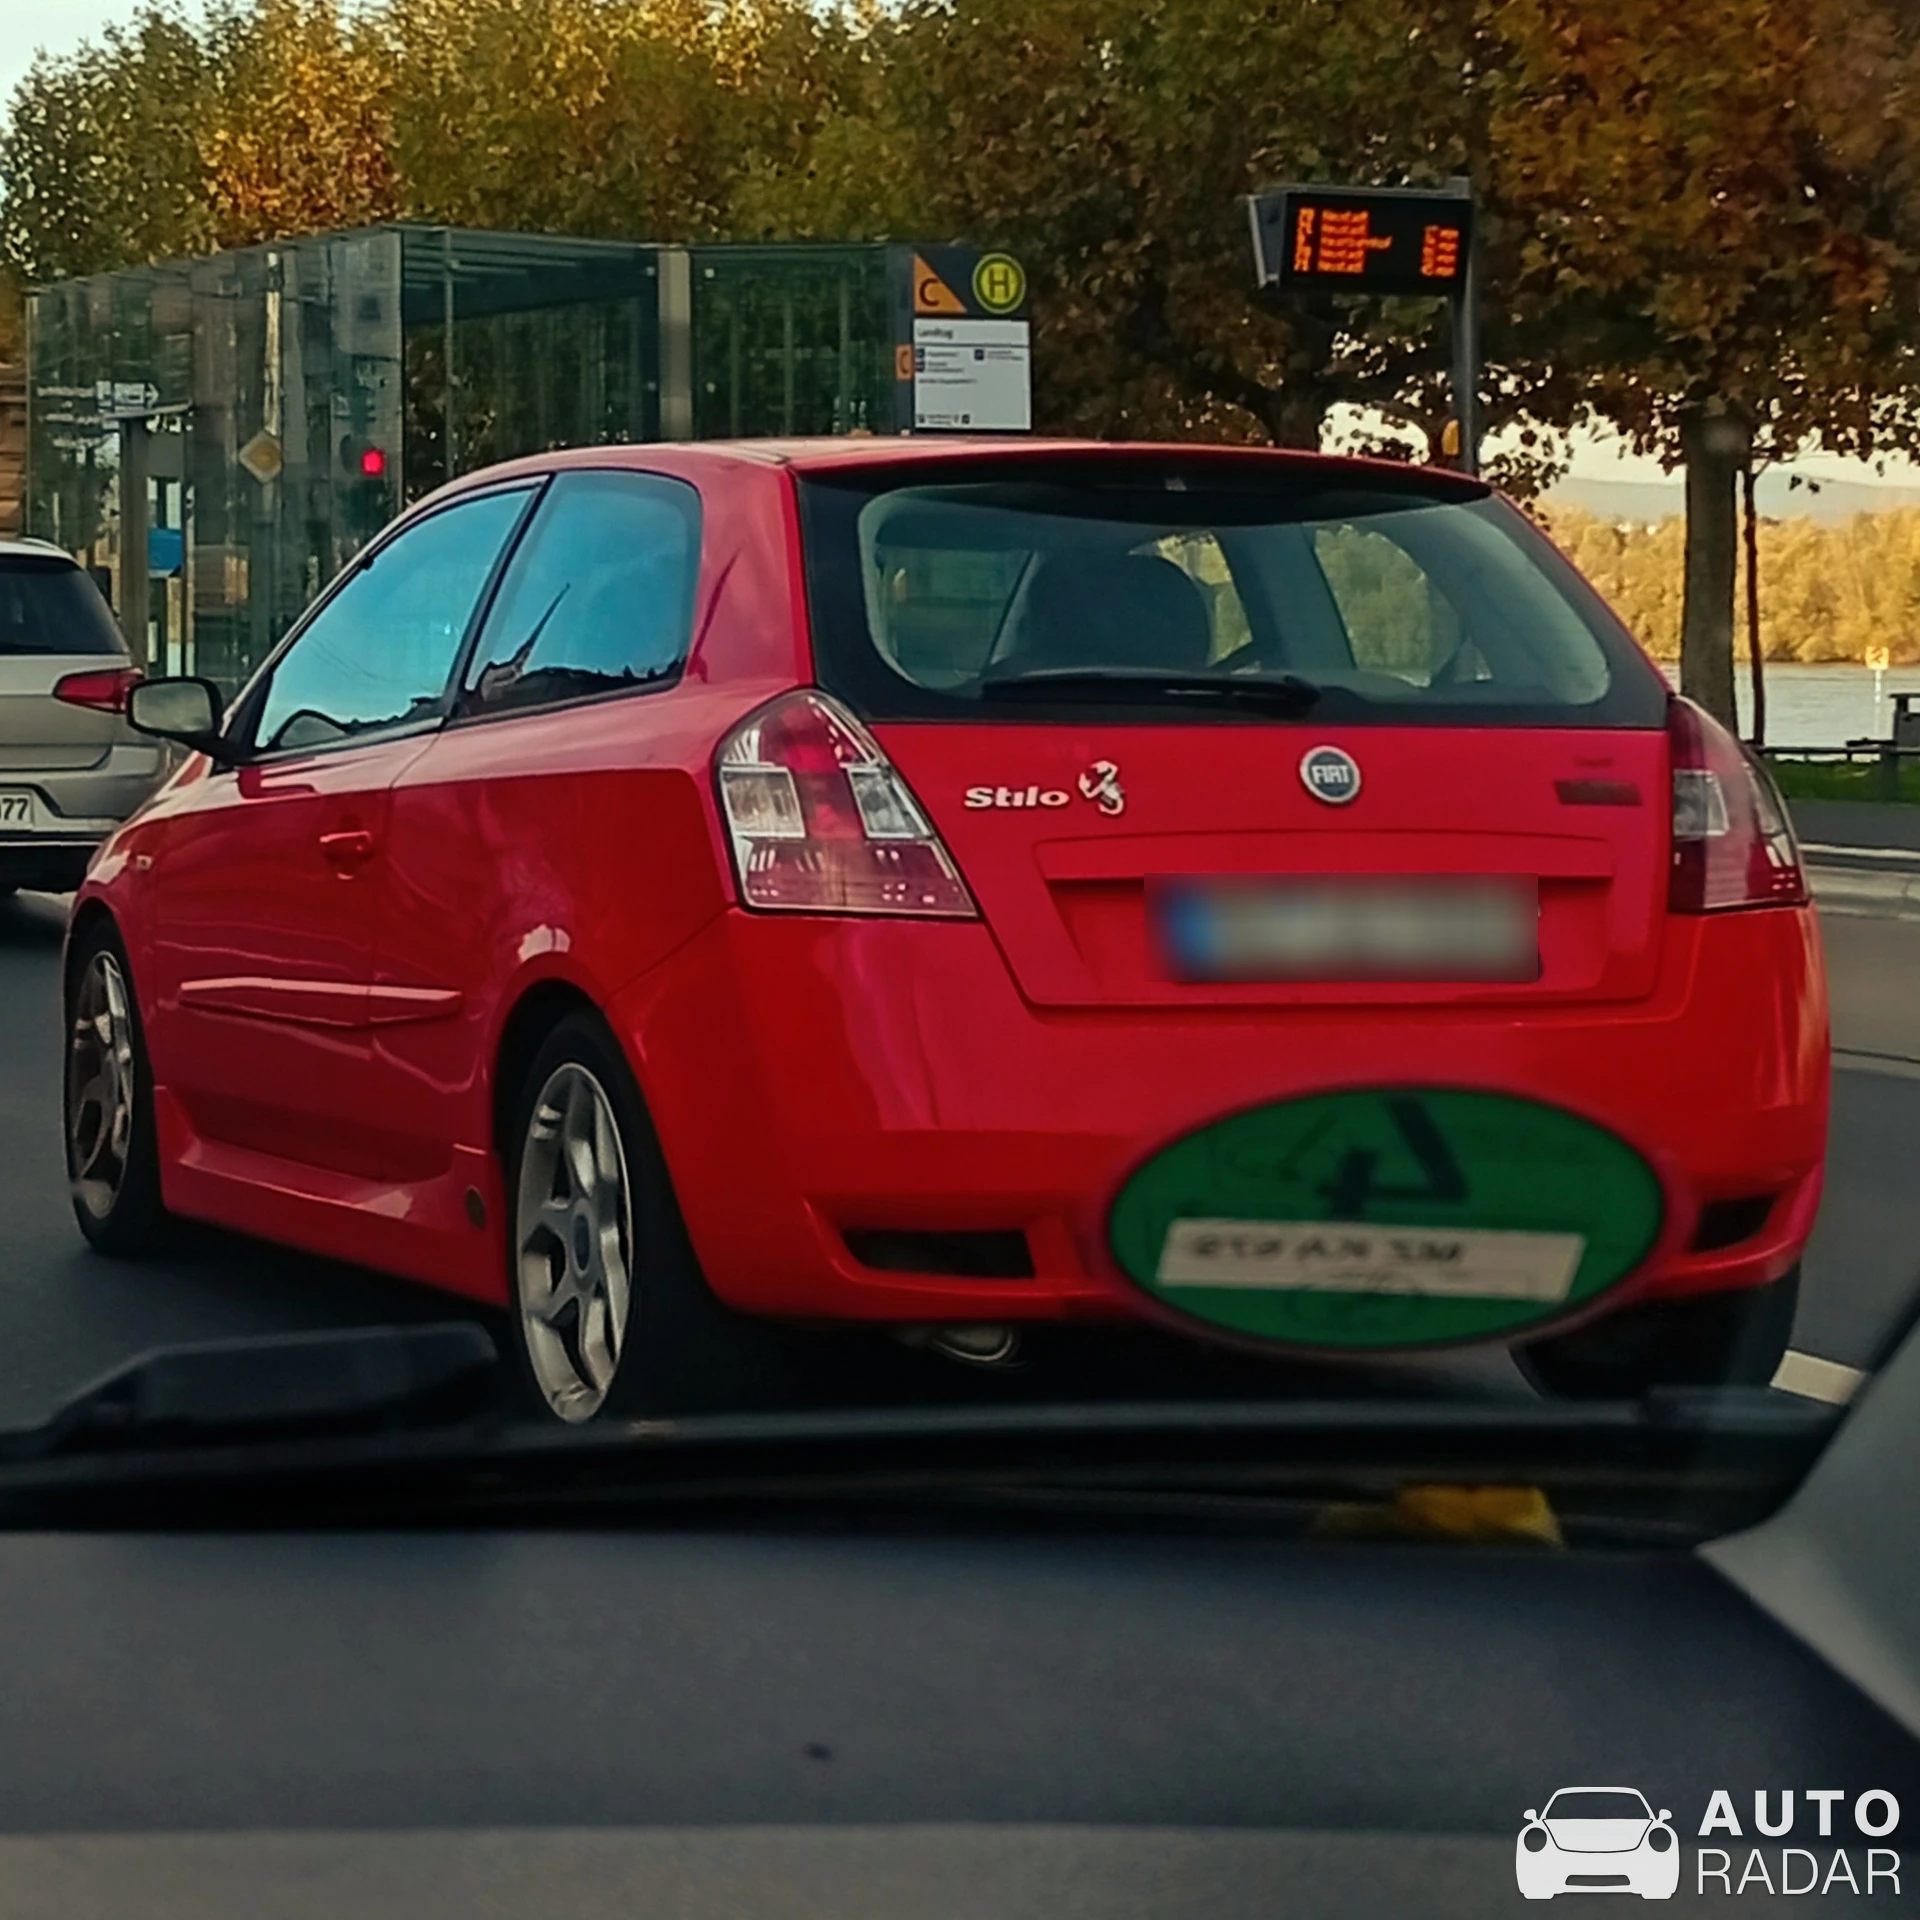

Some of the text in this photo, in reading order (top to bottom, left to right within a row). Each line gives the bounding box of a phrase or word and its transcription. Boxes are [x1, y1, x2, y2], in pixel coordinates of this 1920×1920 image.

[919, 278, 941, 307] C
[988, 268, 1010, 299] H
[1311, 764, 1350, 784] FIAT
[963, 785, 1070, 808] Stilo
[0, 797, 28, 820] 77
